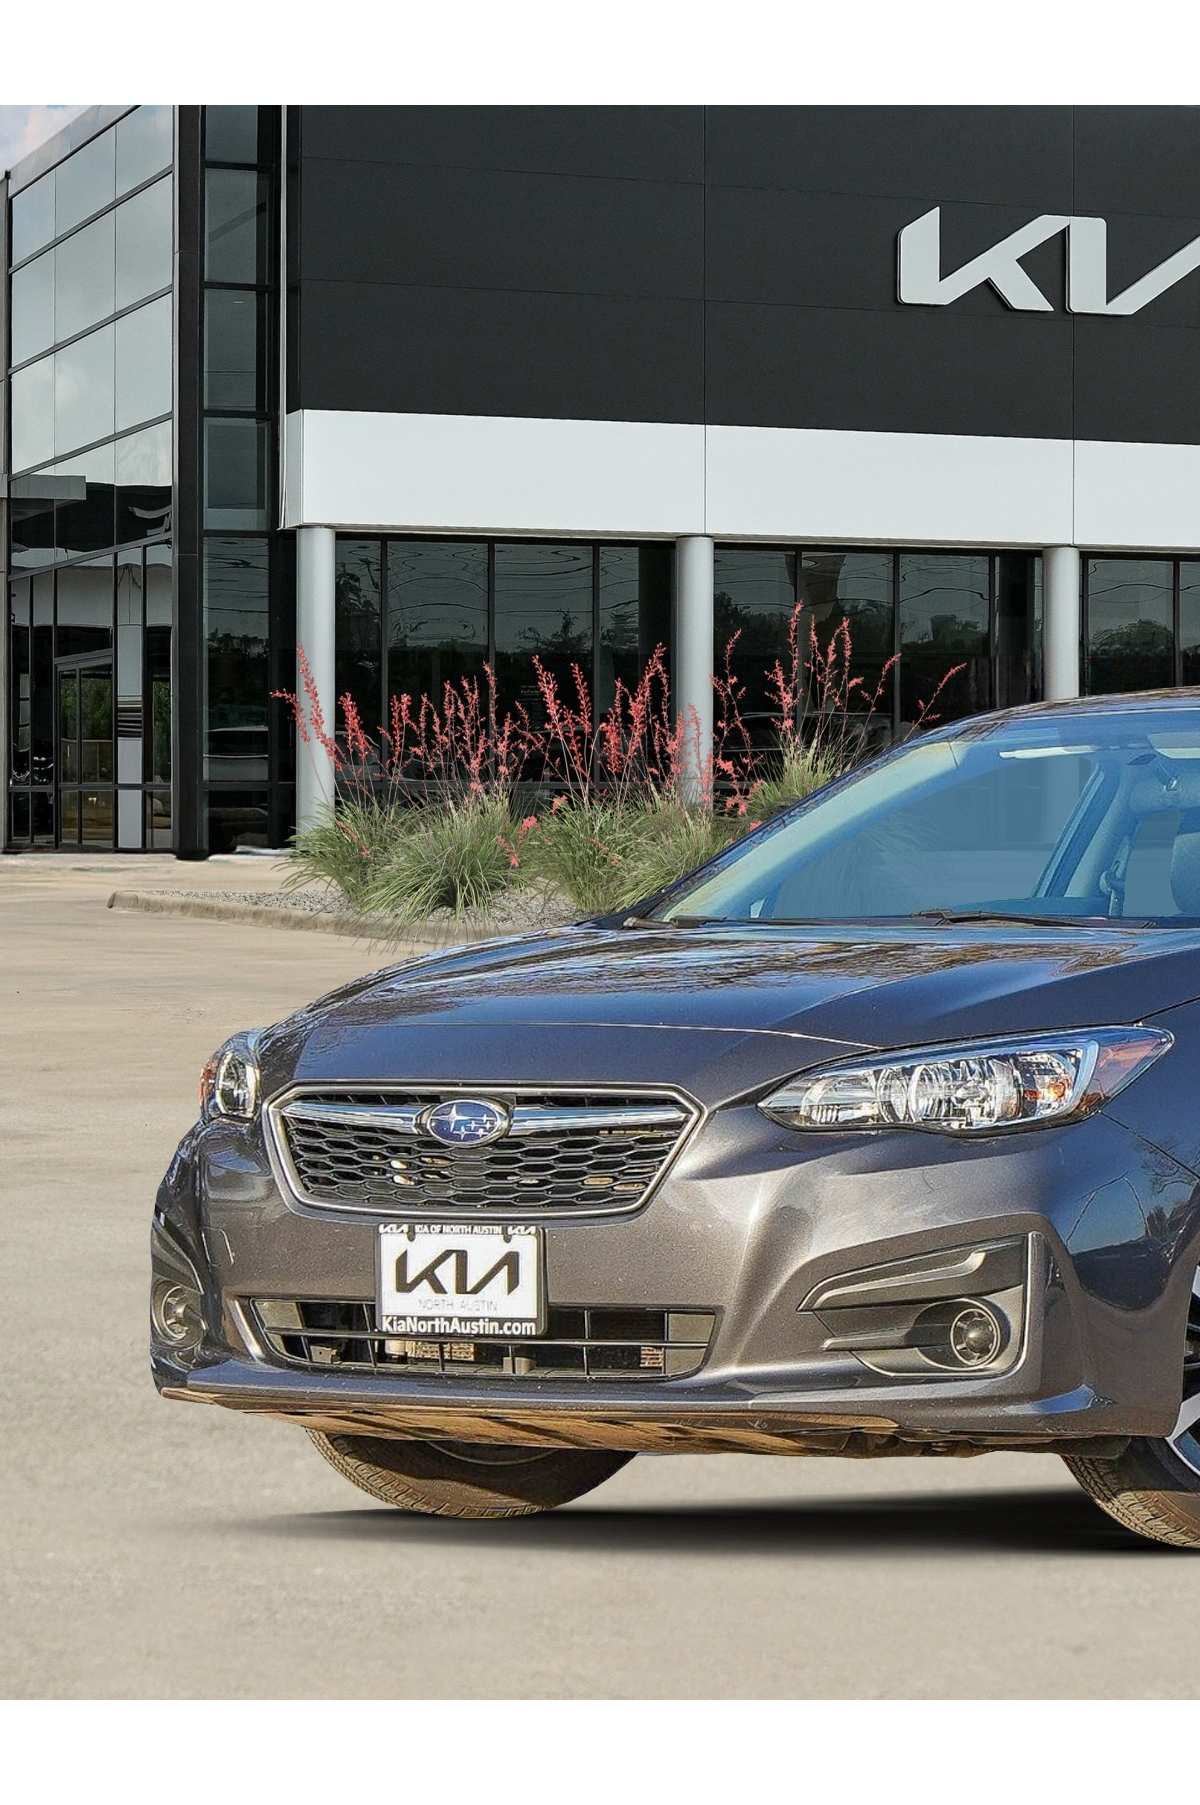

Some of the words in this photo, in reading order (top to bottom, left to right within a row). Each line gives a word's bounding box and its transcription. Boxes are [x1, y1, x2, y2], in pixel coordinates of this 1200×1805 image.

[430, 1225, 442, 1234] OF
[443, 1225, 471, 1234] NORTH
[473, 1226, 502, 1235] AUSTIN
[395, 1249, 520, 1295] KIA
[417, 1299, 453, 1311] NORTH
[382, 1316, 536, 1336] KiaNorthAustin.com
